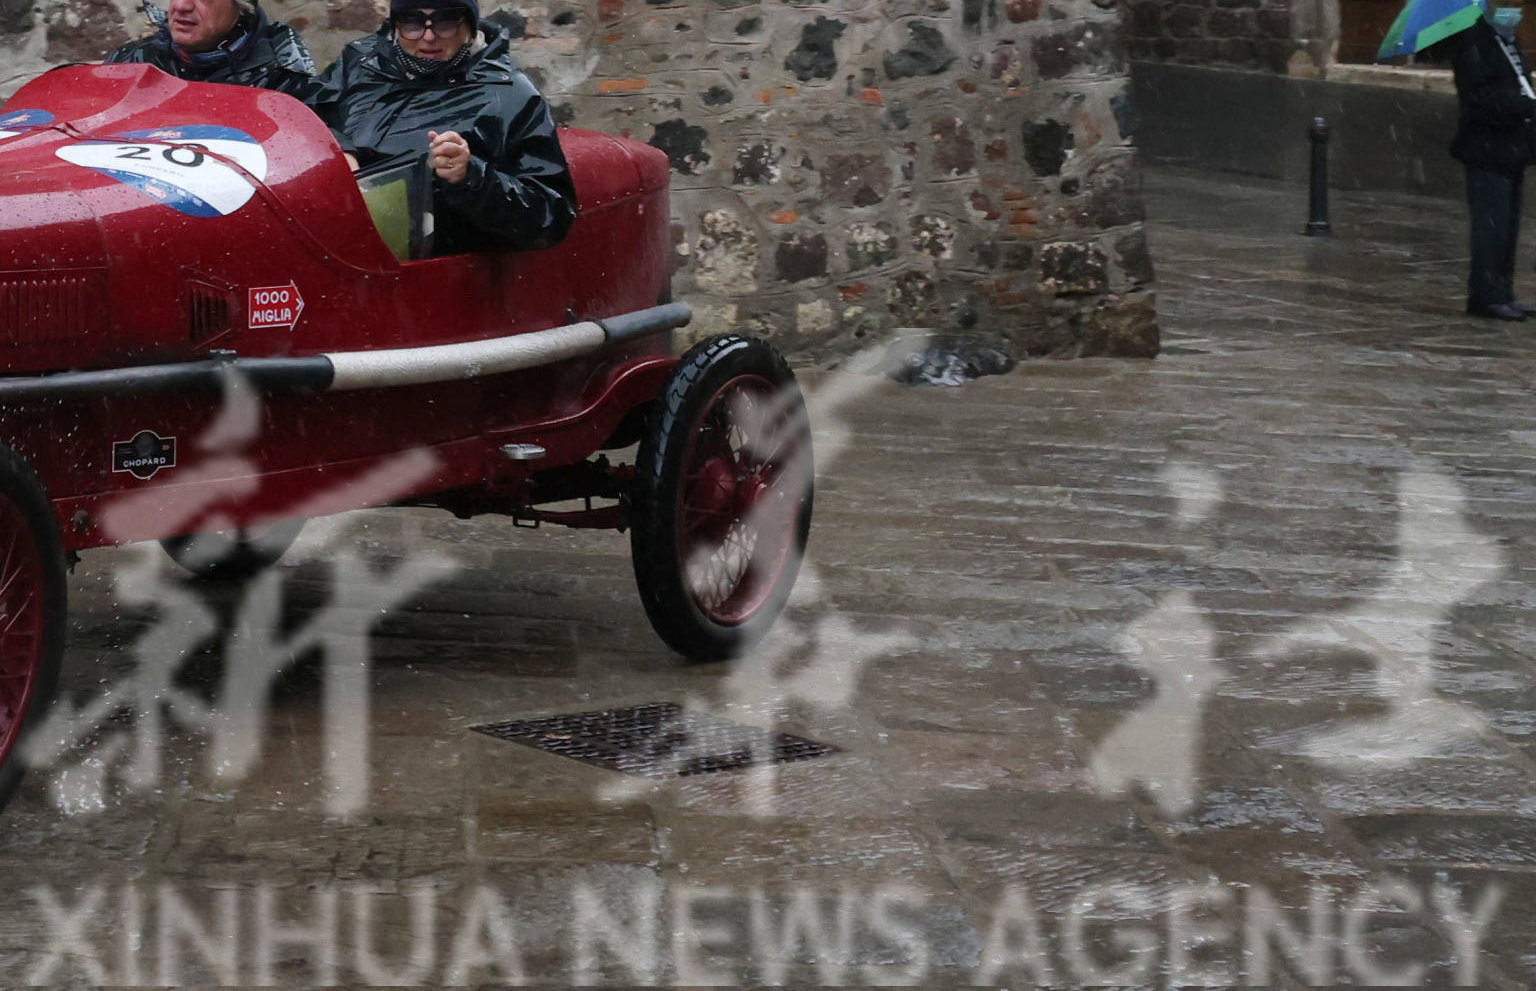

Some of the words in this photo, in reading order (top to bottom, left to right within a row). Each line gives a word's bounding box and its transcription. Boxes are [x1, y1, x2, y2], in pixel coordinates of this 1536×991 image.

[116, 143, 208, 168] 20
[254, 290, 290, 305] 1000
[252, 308, 292, 324] MIGLIA
[123, 457, 166, 467] CHOPARD
